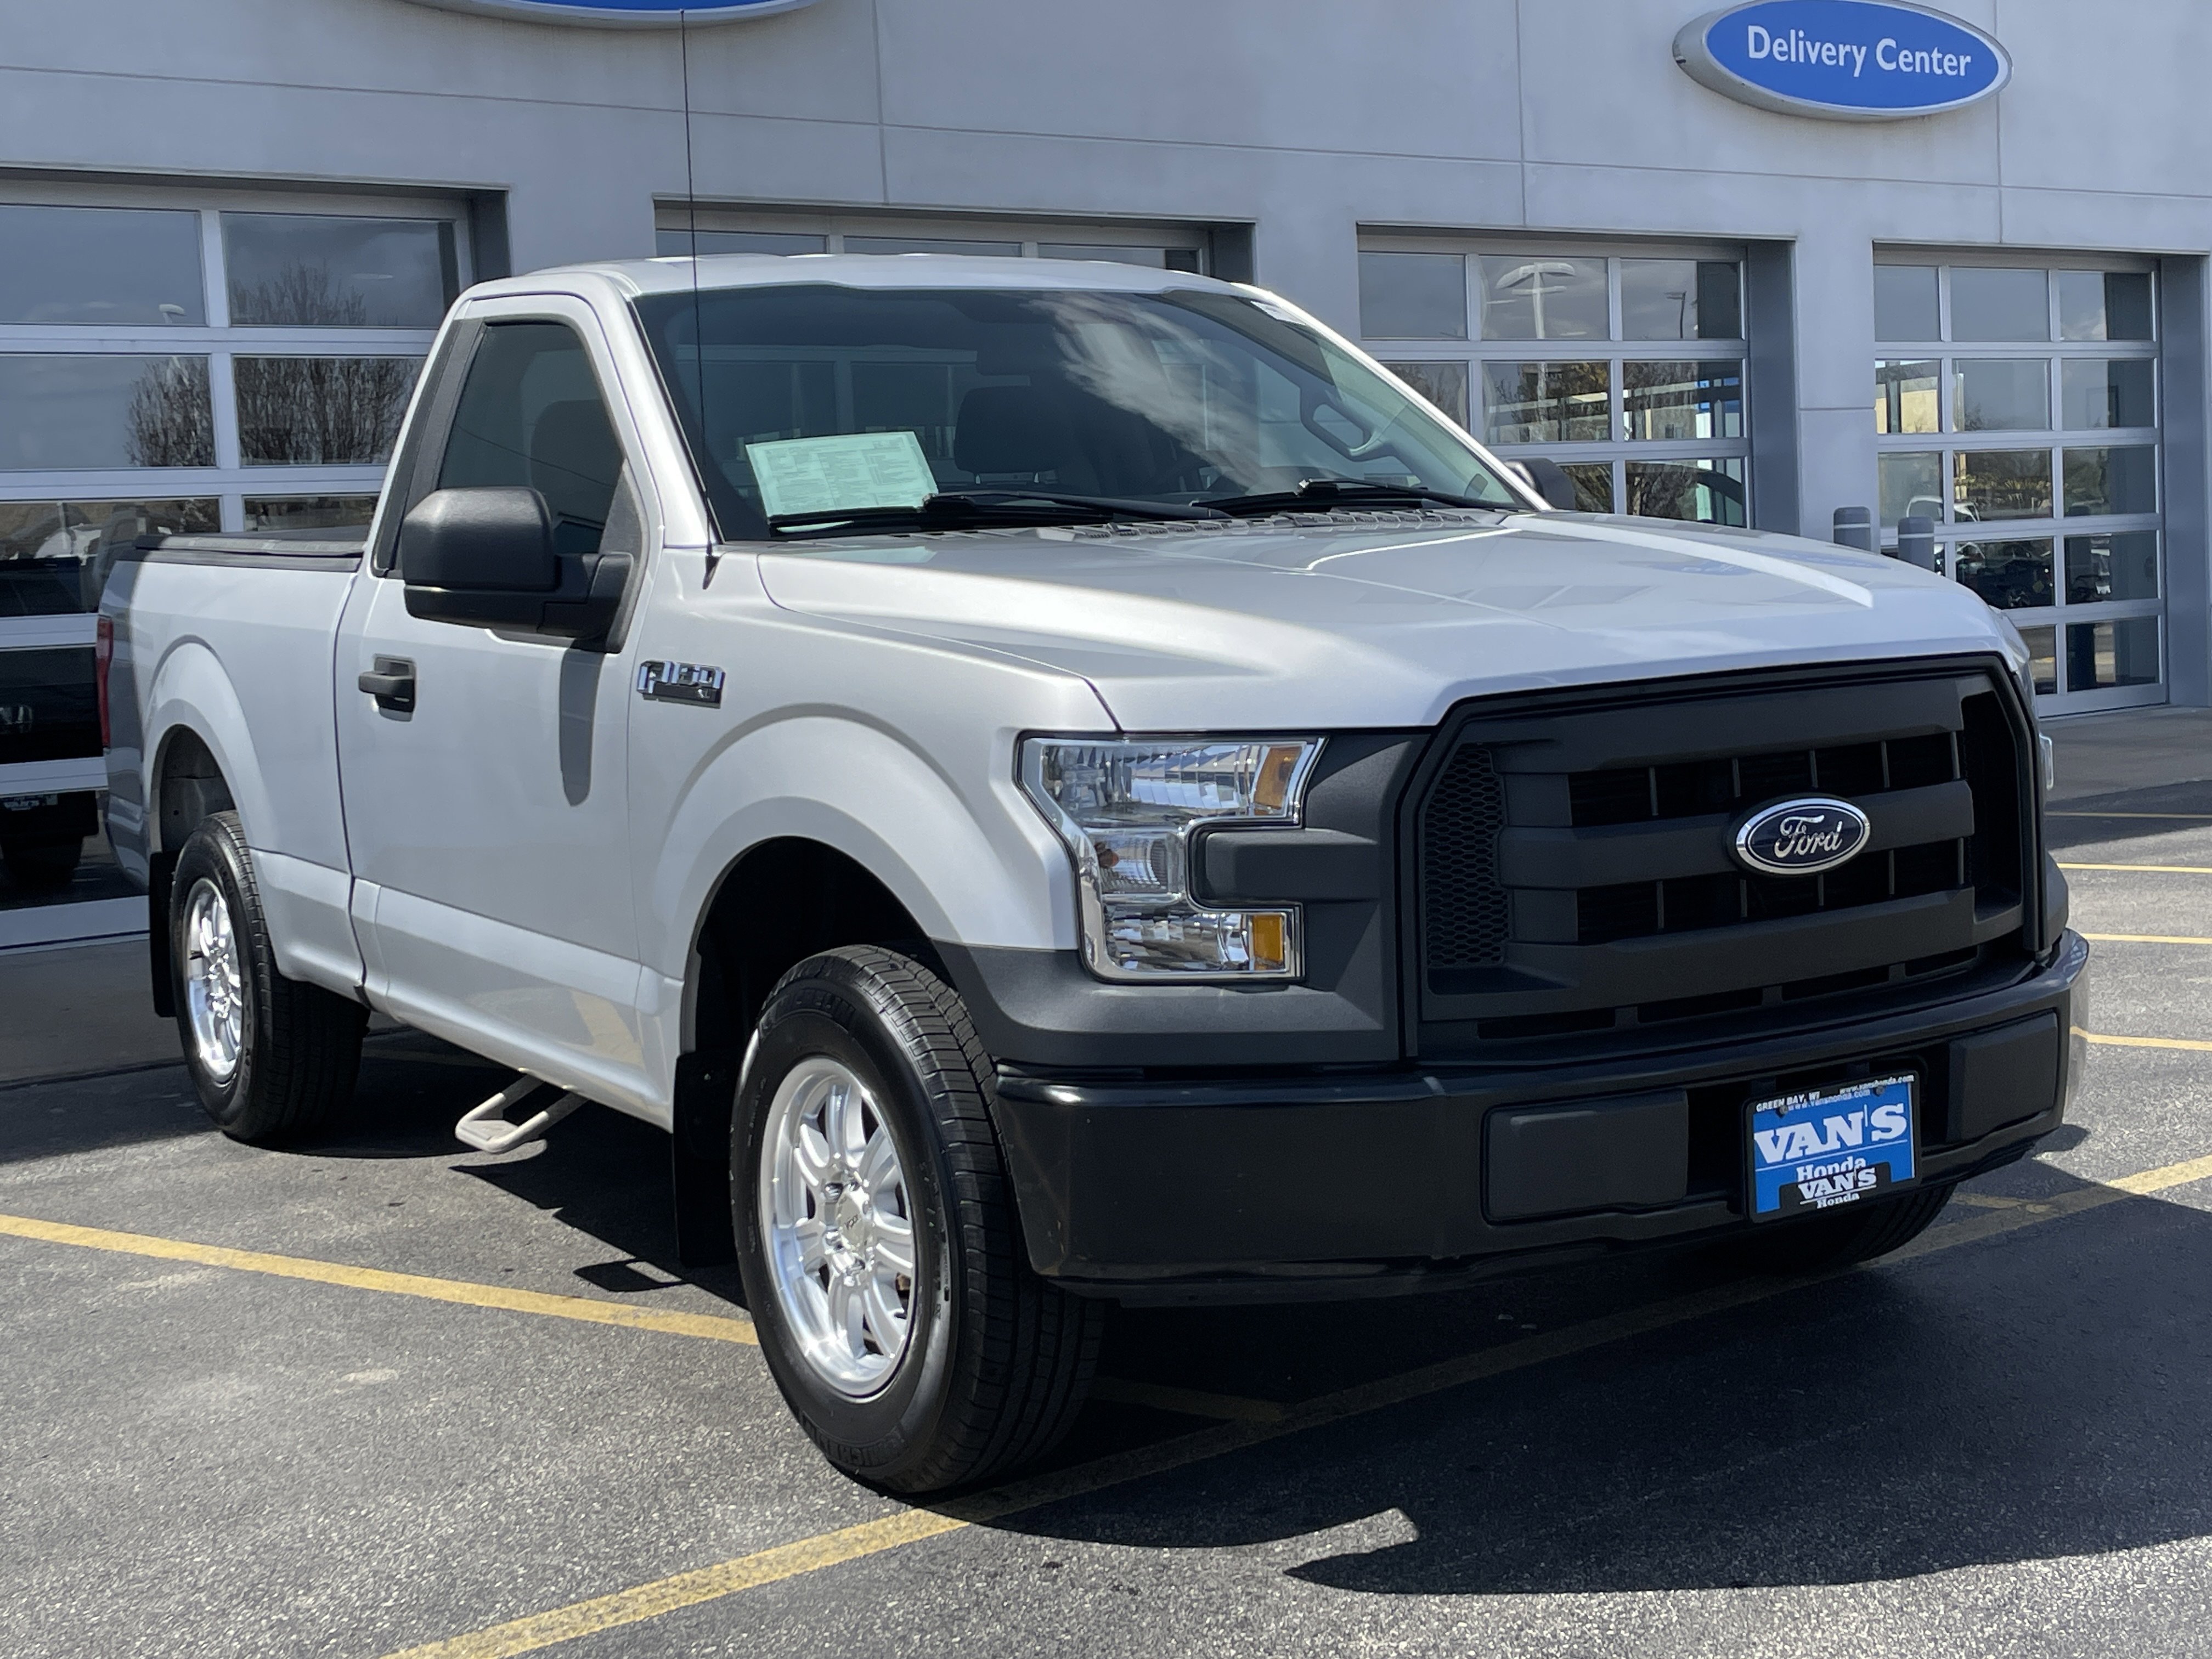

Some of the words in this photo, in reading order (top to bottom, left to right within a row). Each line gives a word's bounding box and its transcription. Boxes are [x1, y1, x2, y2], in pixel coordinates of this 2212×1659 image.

[1747, 25, 1867, 77] Delivery
[1875, 38, 1972, 77] Center
[1774, 815, 1843, 858] Ford
[1756, 1098, 1785, 1112] GREEN
[1809, 1091, 1821, 1101] WI
[1753, 1103, 1908, 1164] VAN'S
[1797, 1156, 1866, 1182] Honda
[1798, 1167, 1877, 1200] VAN'S
[1816, 1192, 1860, 1209] Honda
